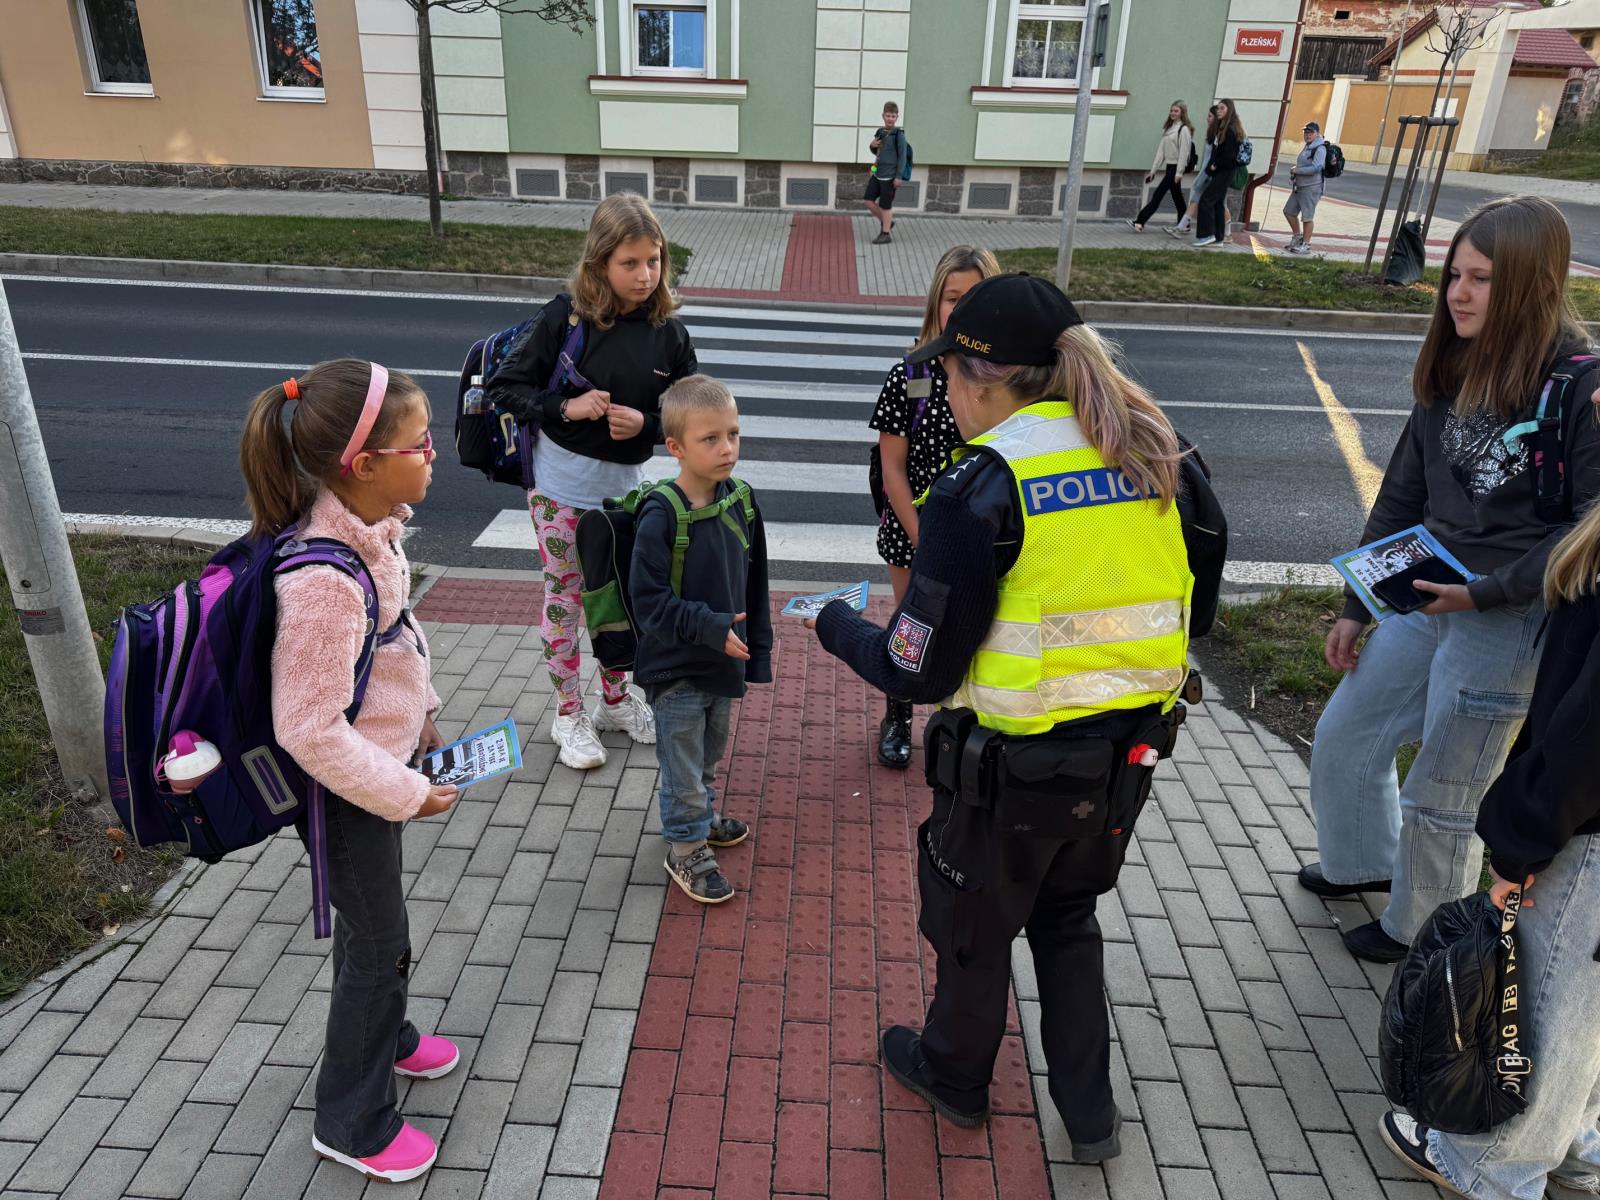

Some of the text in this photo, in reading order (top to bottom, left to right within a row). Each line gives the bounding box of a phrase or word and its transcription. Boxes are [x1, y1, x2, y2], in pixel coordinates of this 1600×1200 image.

[1241, 37, 1277, 47] PLZEŇSKÁ
[956, 332, 992, 354] POLICIE
[1029, 472, 1159, 510] POLIC
[890, 651, 918, 670] POLICIE
[1504, 986, 1517, 1010] FB
[1502, 1024, 1523, 1067] BAG
